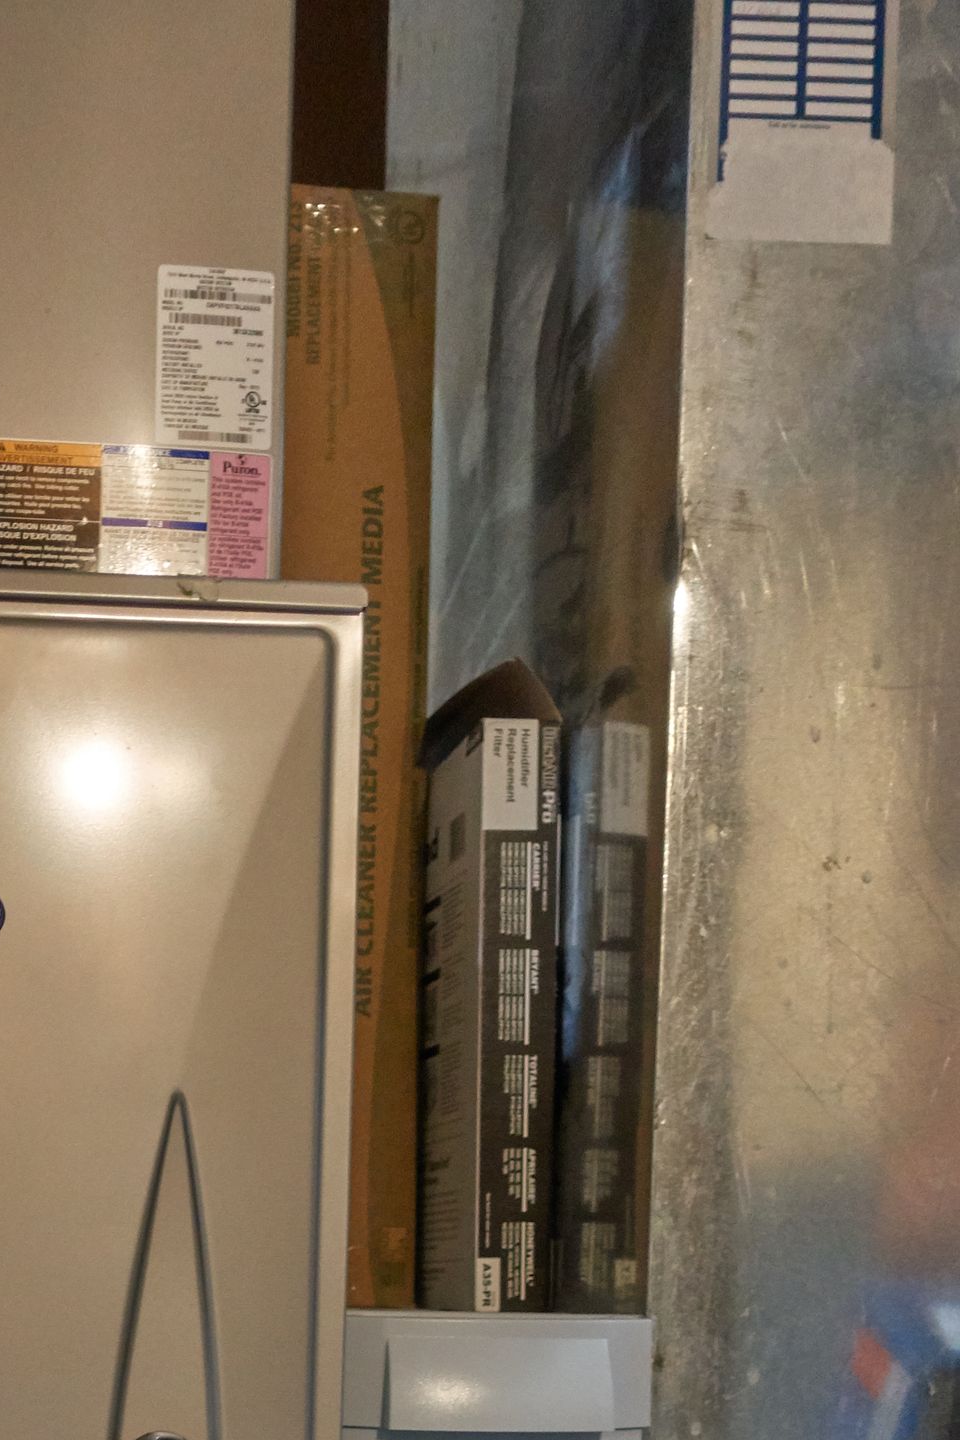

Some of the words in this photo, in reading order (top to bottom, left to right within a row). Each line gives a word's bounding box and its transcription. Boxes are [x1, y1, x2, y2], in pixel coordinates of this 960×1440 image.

[306, 255, 321, 364] REPLACEMENT
[15, 444, 58, 453] WARNING
[34, 466, 64, 474] RISQUE
[66, 467, 76, 475] DE
[22, 532, 77, 541] D'EXPLOSION
[39, 523, 74, 532] HAZARD
[362, 485, 385, 585] MEDIA
[494, 728, 504, 757] Filter
[521, 728, 531, 787] Humidifier
[506, 728, 517, 802] Replacement
[542, 791, 558, 824] Pro
[356, 824, 376, 957] CLEANER
[482, 1263, 492, 1307] A35-PR
